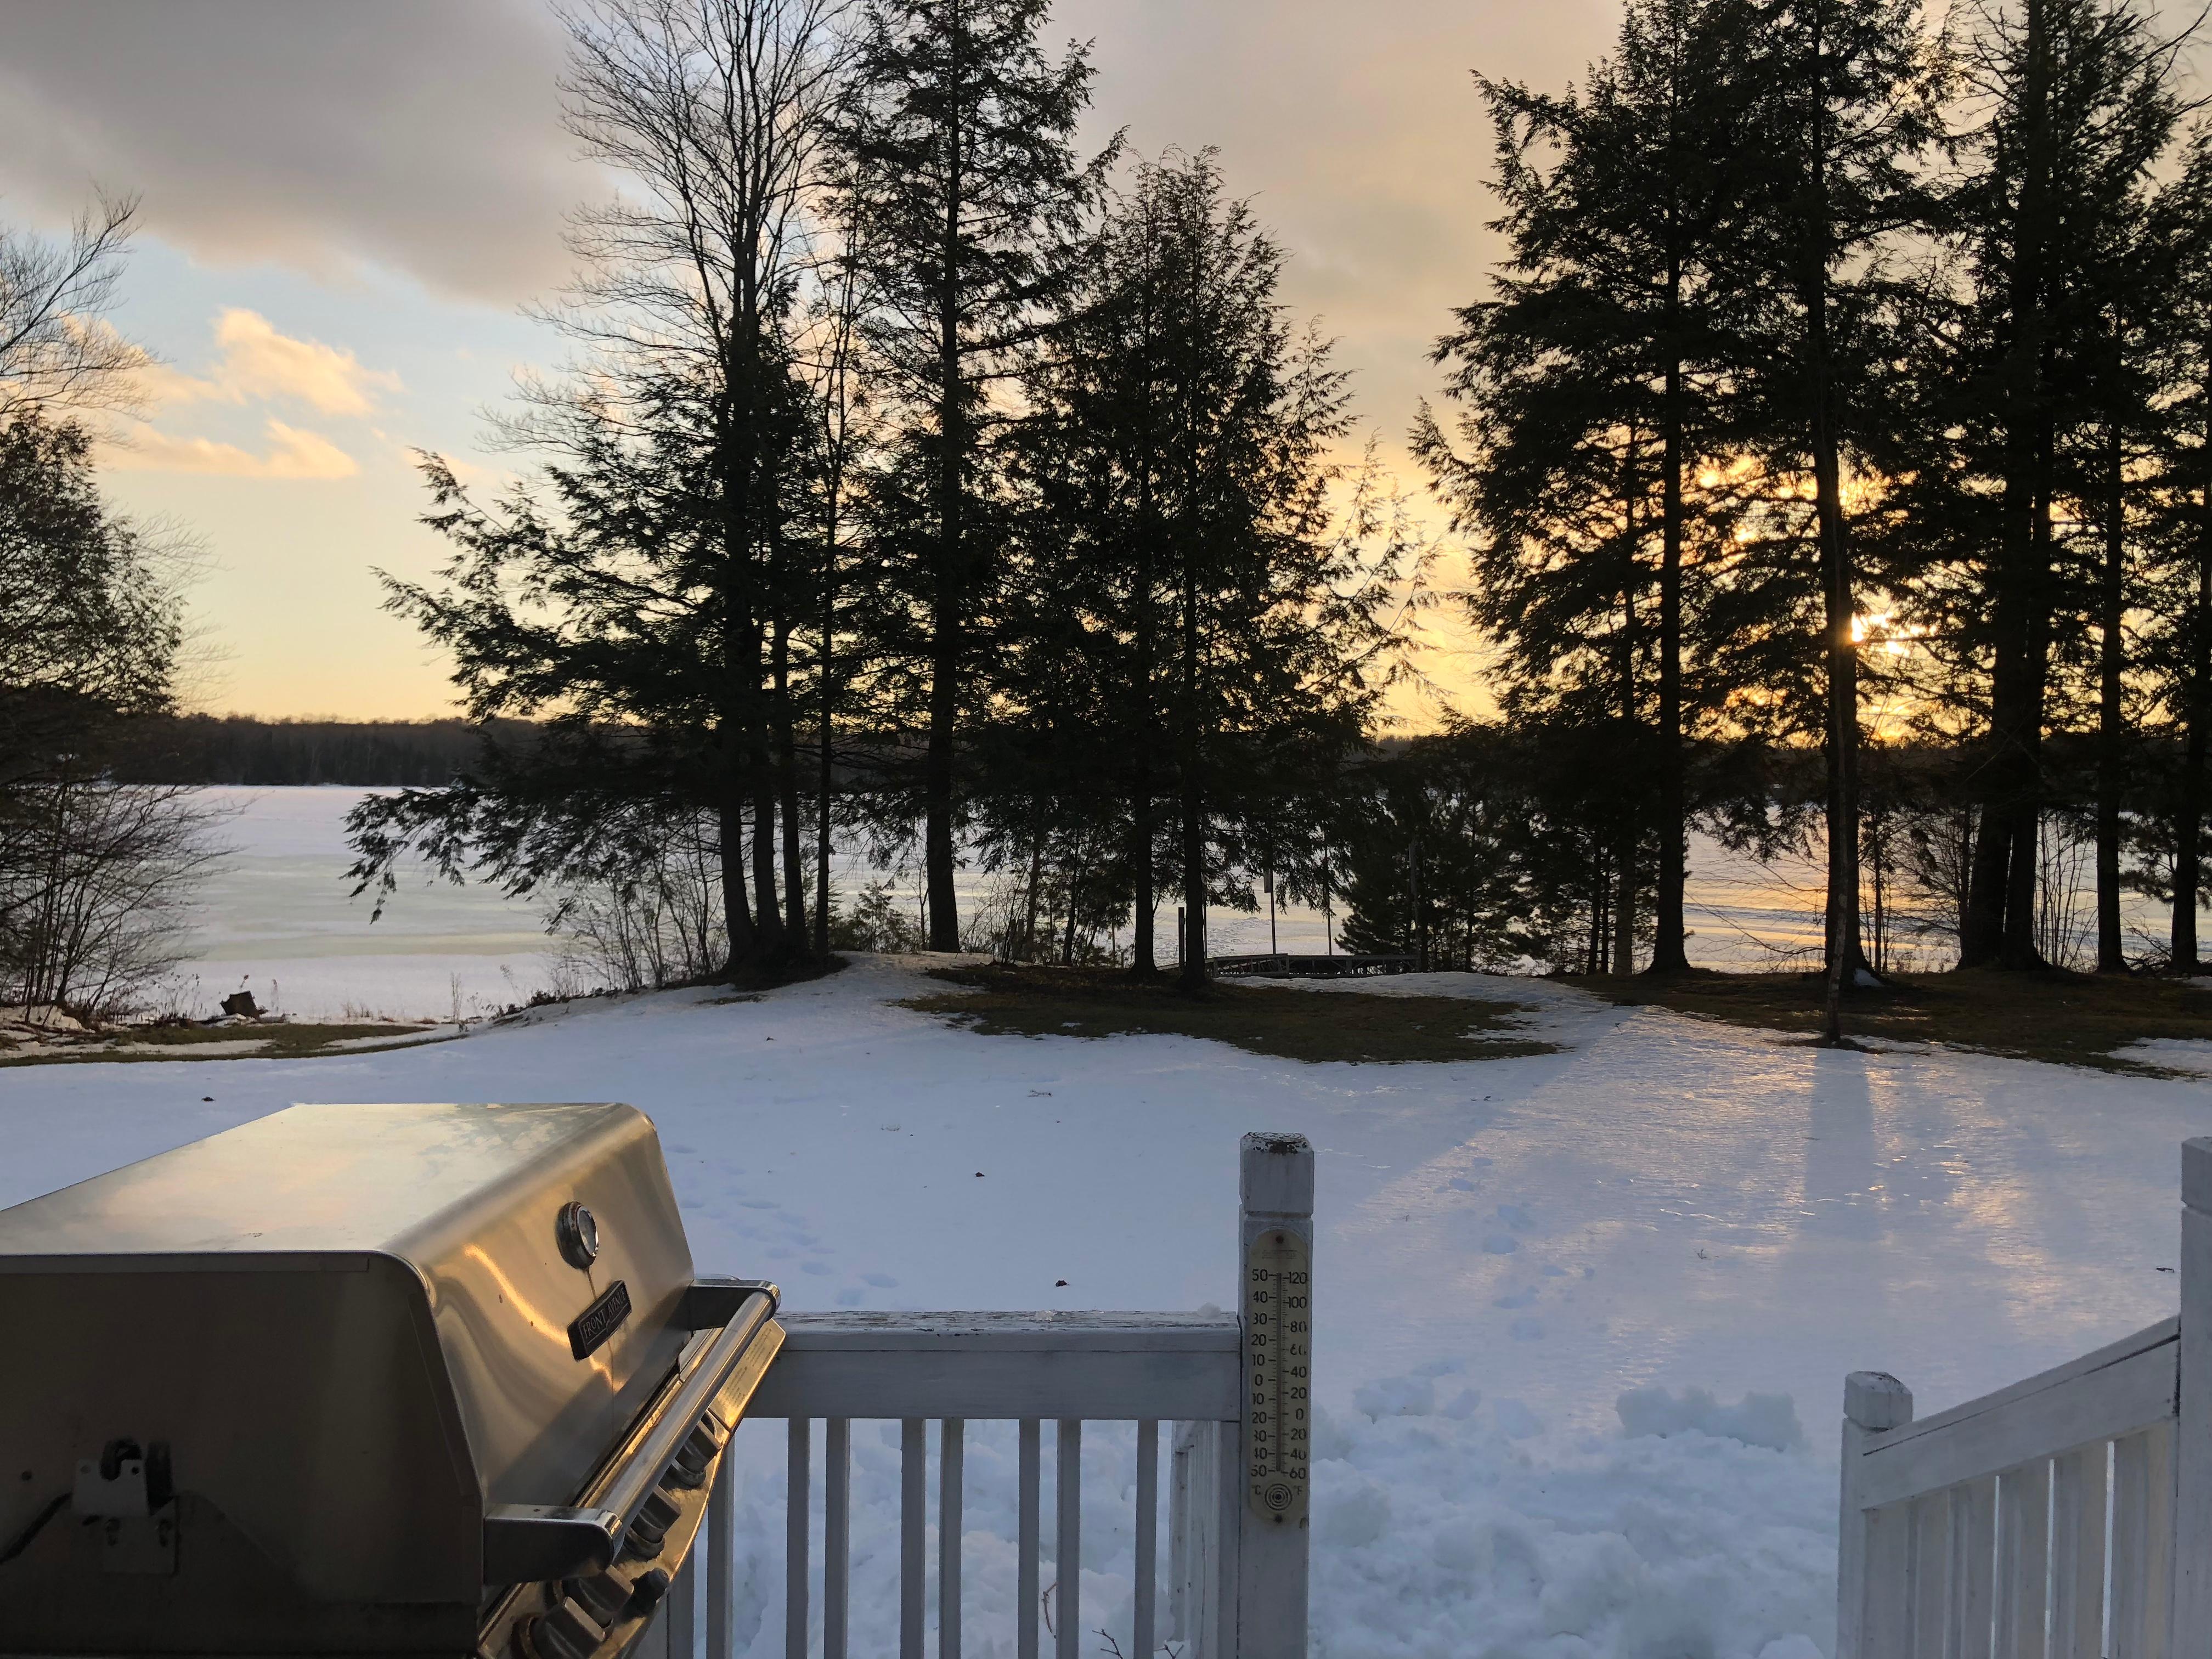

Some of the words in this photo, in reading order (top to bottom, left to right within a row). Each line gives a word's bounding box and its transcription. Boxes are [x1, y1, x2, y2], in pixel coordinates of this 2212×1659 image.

[1252, 1269, 1268, 1281] 50
[1288, 1272, 1308, 1284] 120
[1253, 1291, 1268, 1303] 40
[1288, 1296, 1307, 1308] 100
[583, 1308, 606, 1339] FRONT
[607, 1288, 626, 1318] AVENUE
[1253, 1313, 1267, 1325] 30
[1290, 1321, 1307, 1333] 80
[1251, 1334, 1266, 1346] 20
[1252, 1354, 1265, 1365] 10
[1290, 1366, 1307, 1378] 40
[1255, 1374, 1263, 1386] 0
[1252, 1393, 1264, 1404] 10
[1290, 1387, 1307, 1399] 20
[1251, 1412, 1267, 1424] 20
[1295, 1408, 1304, 1420] 0
[1291, 1428, 1306, 1440] 20
[1290, 1447, 1306, 1460] 40
[1251, 1465, 1267, 1477] 50
[1290, 1468, 1306, 1479] 60
